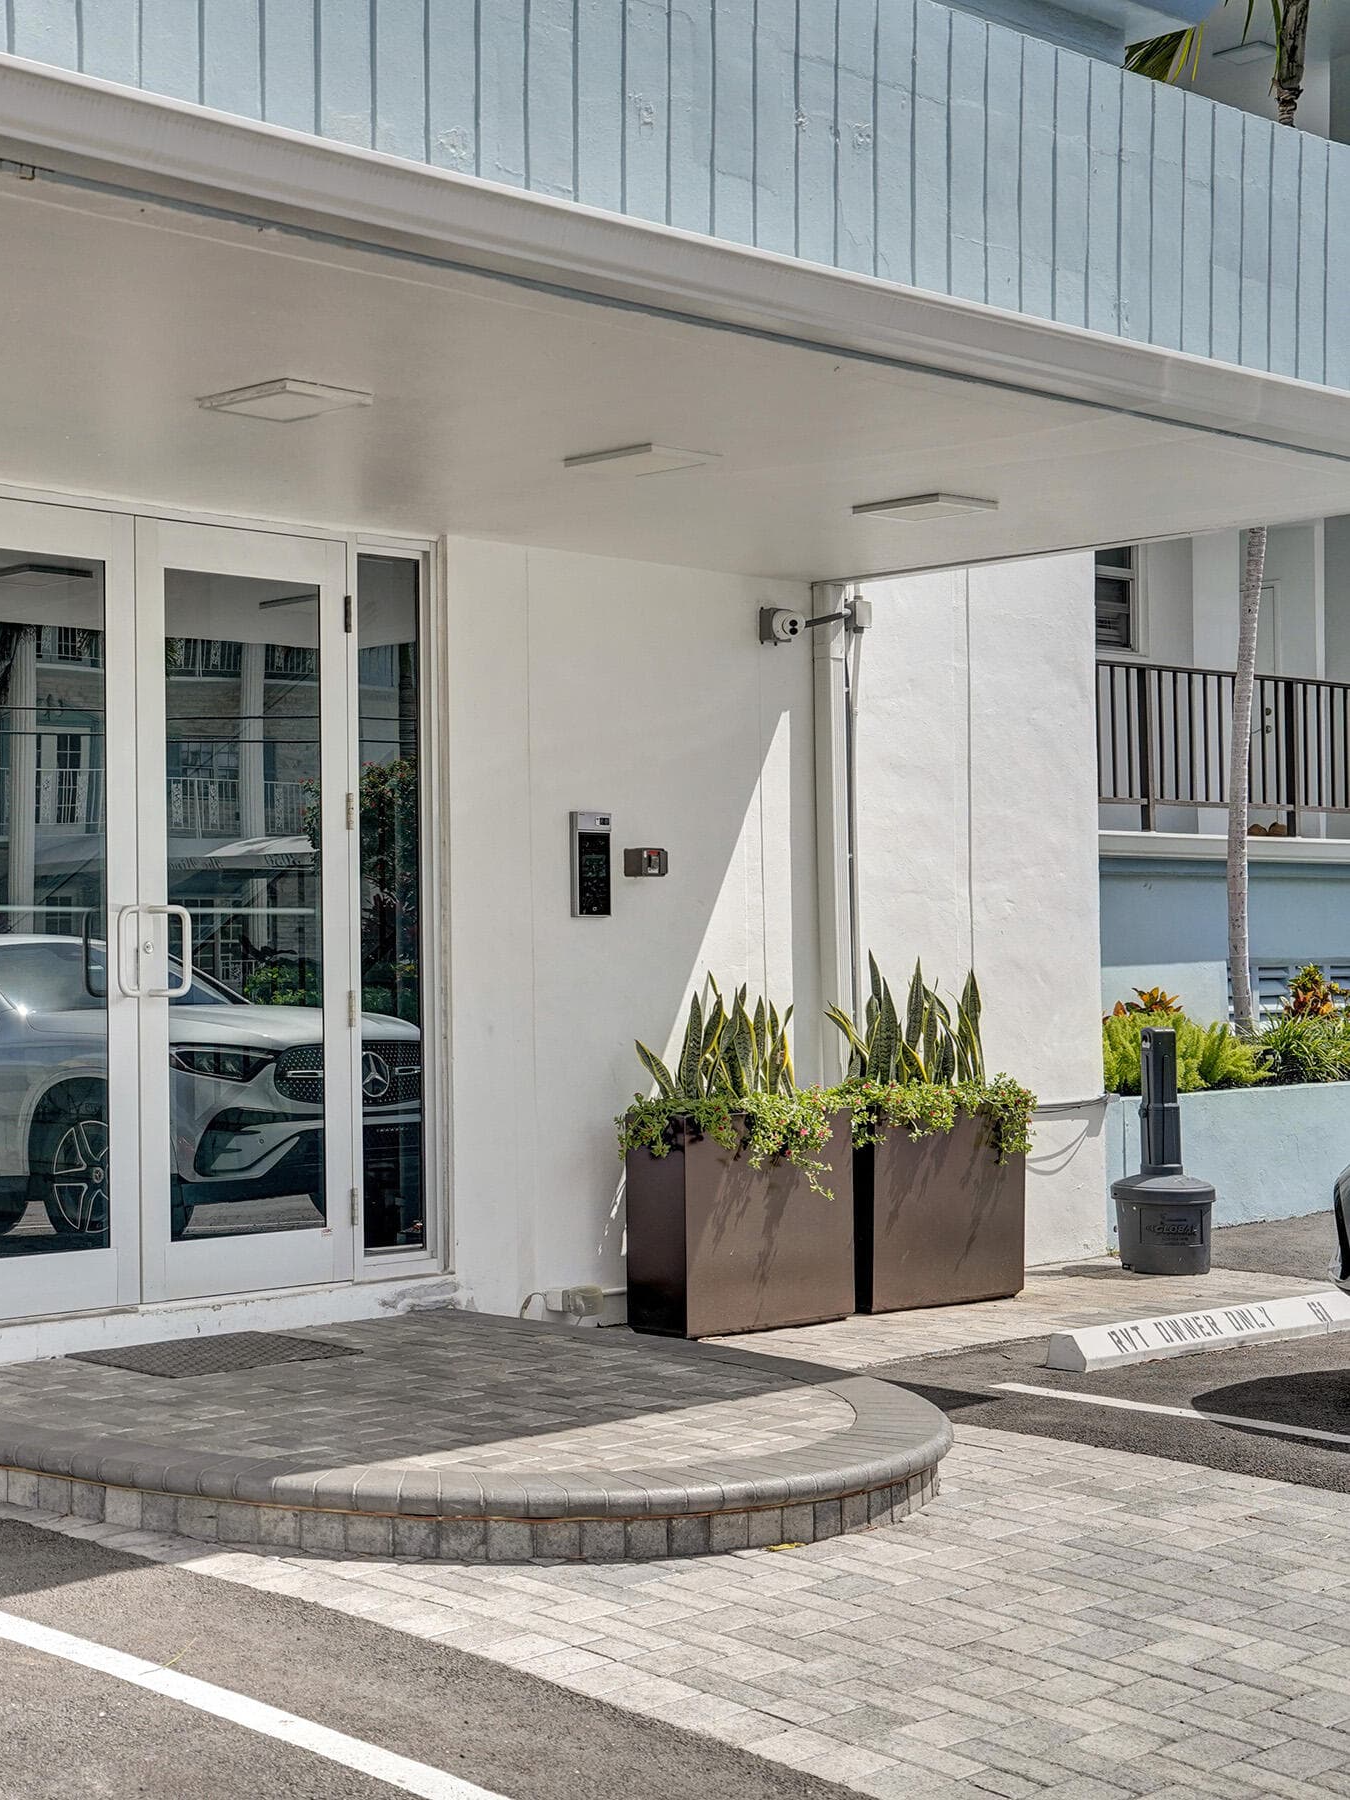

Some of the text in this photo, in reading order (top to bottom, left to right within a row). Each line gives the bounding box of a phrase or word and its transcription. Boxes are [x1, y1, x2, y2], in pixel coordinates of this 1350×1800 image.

[1107, 1326, 1151, 1354] RVT
[1153, 1314, 1224, 1344] OWNER
[1224, 1306, 1276, 1332] ONLY
